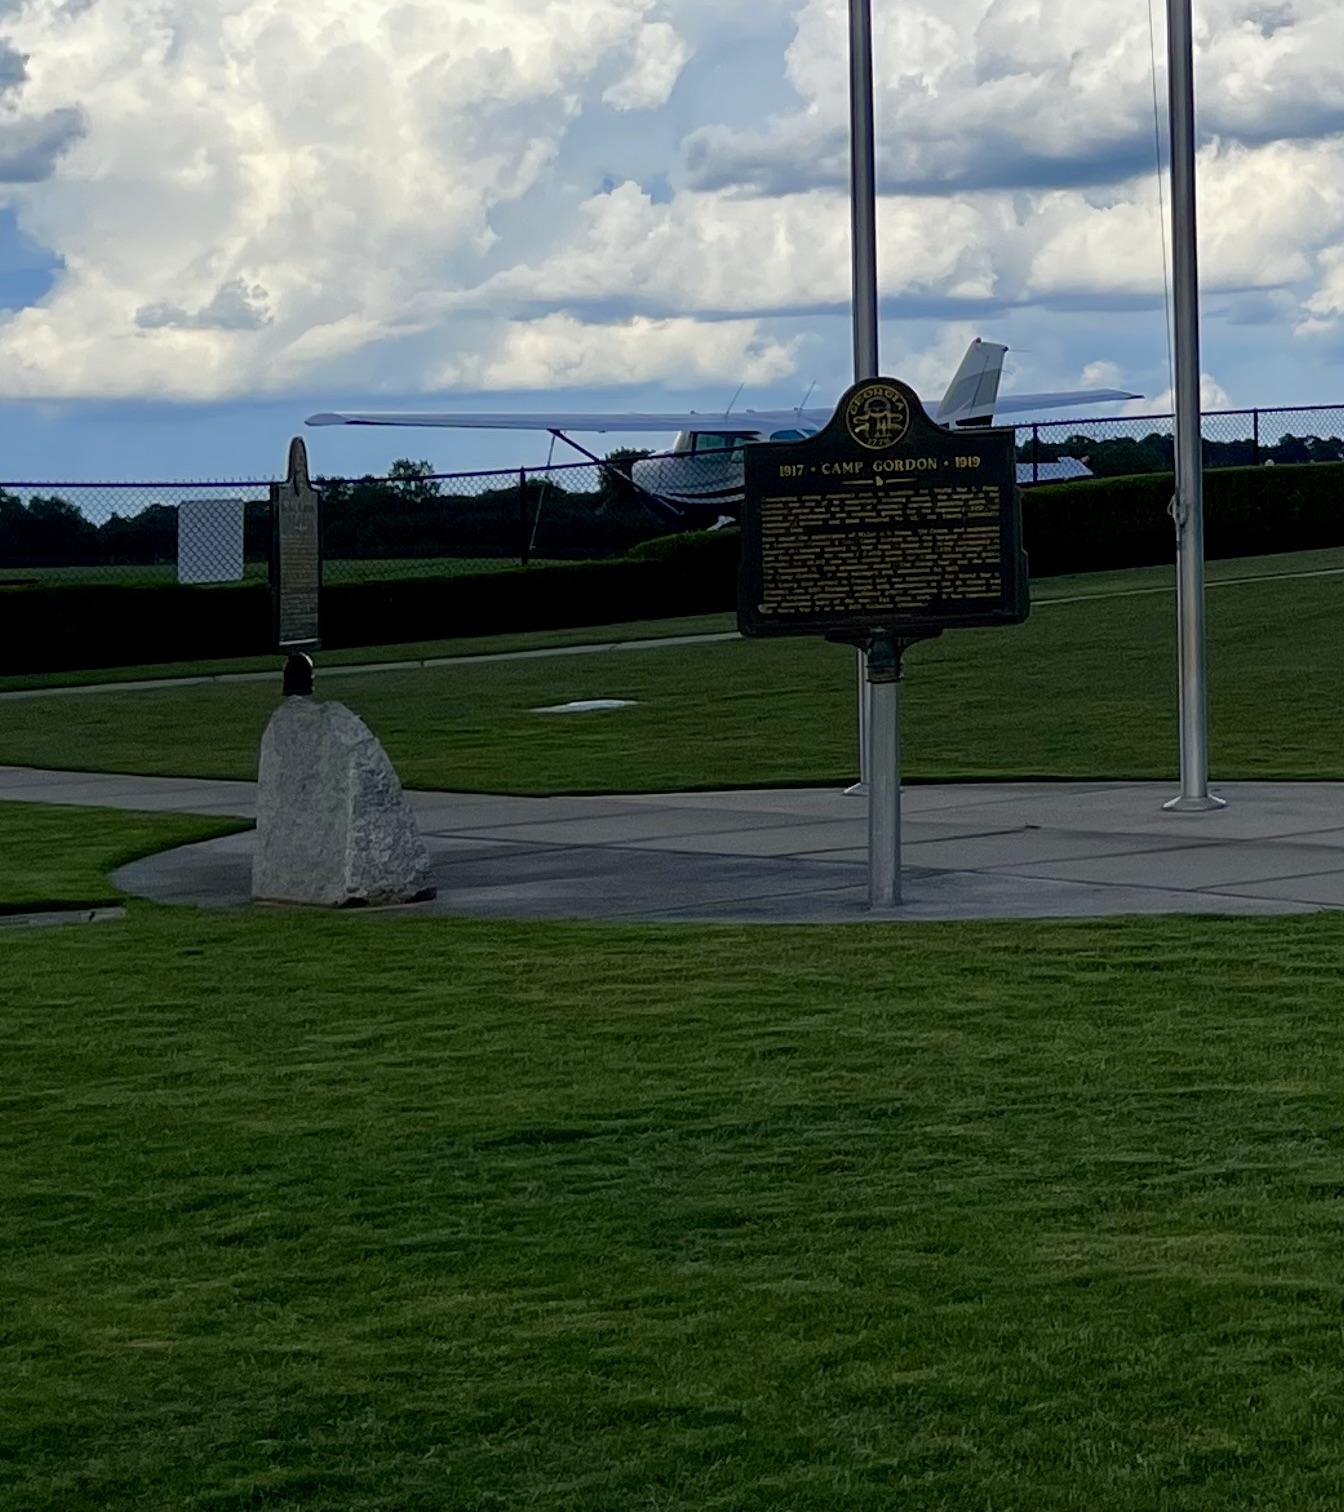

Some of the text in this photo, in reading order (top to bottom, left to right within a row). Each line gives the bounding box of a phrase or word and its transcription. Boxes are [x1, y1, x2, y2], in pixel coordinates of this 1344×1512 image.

[850, 388, 905, 415] GEORGIA
[779, 455, 981, 477] 1917 CAMP GORDON 1919
